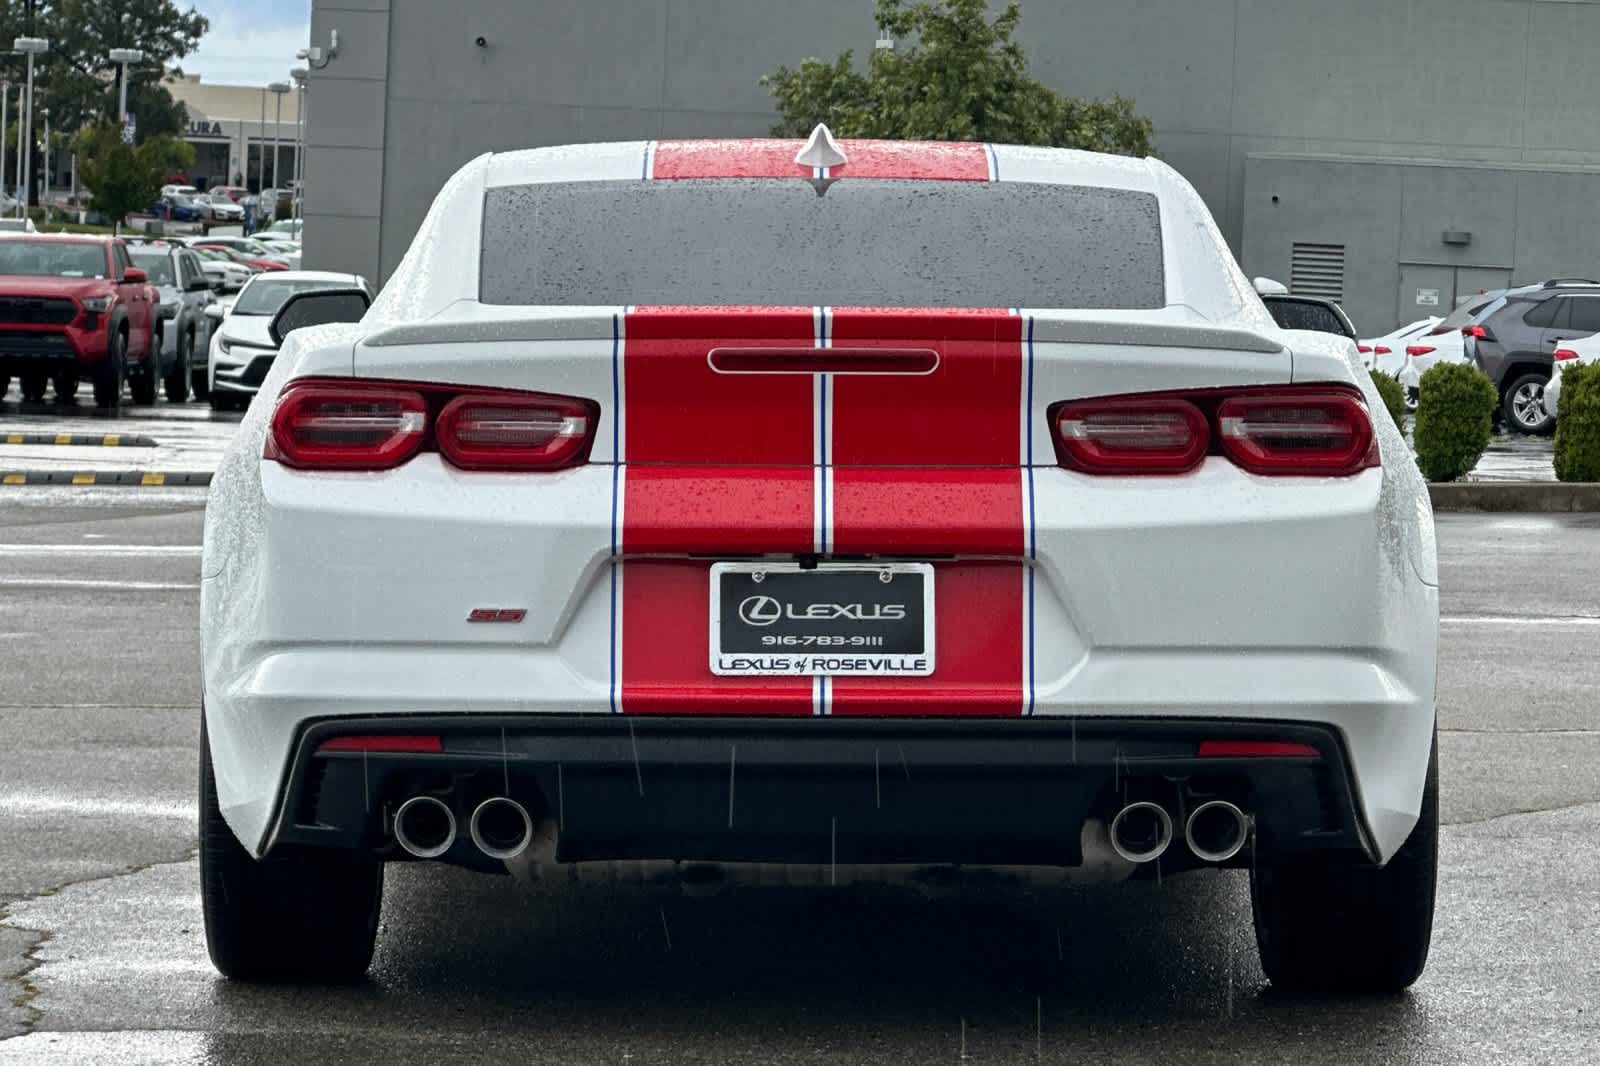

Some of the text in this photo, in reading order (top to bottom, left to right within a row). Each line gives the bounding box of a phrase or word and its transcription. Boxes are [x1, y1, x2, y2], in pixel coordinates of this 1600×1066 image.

[786, 603, 906, 619] LEXUS
[762, 635, 883, 646] 916-783-9111
[719, 657, 926, 674] LEXUS of ROSEVILLE
